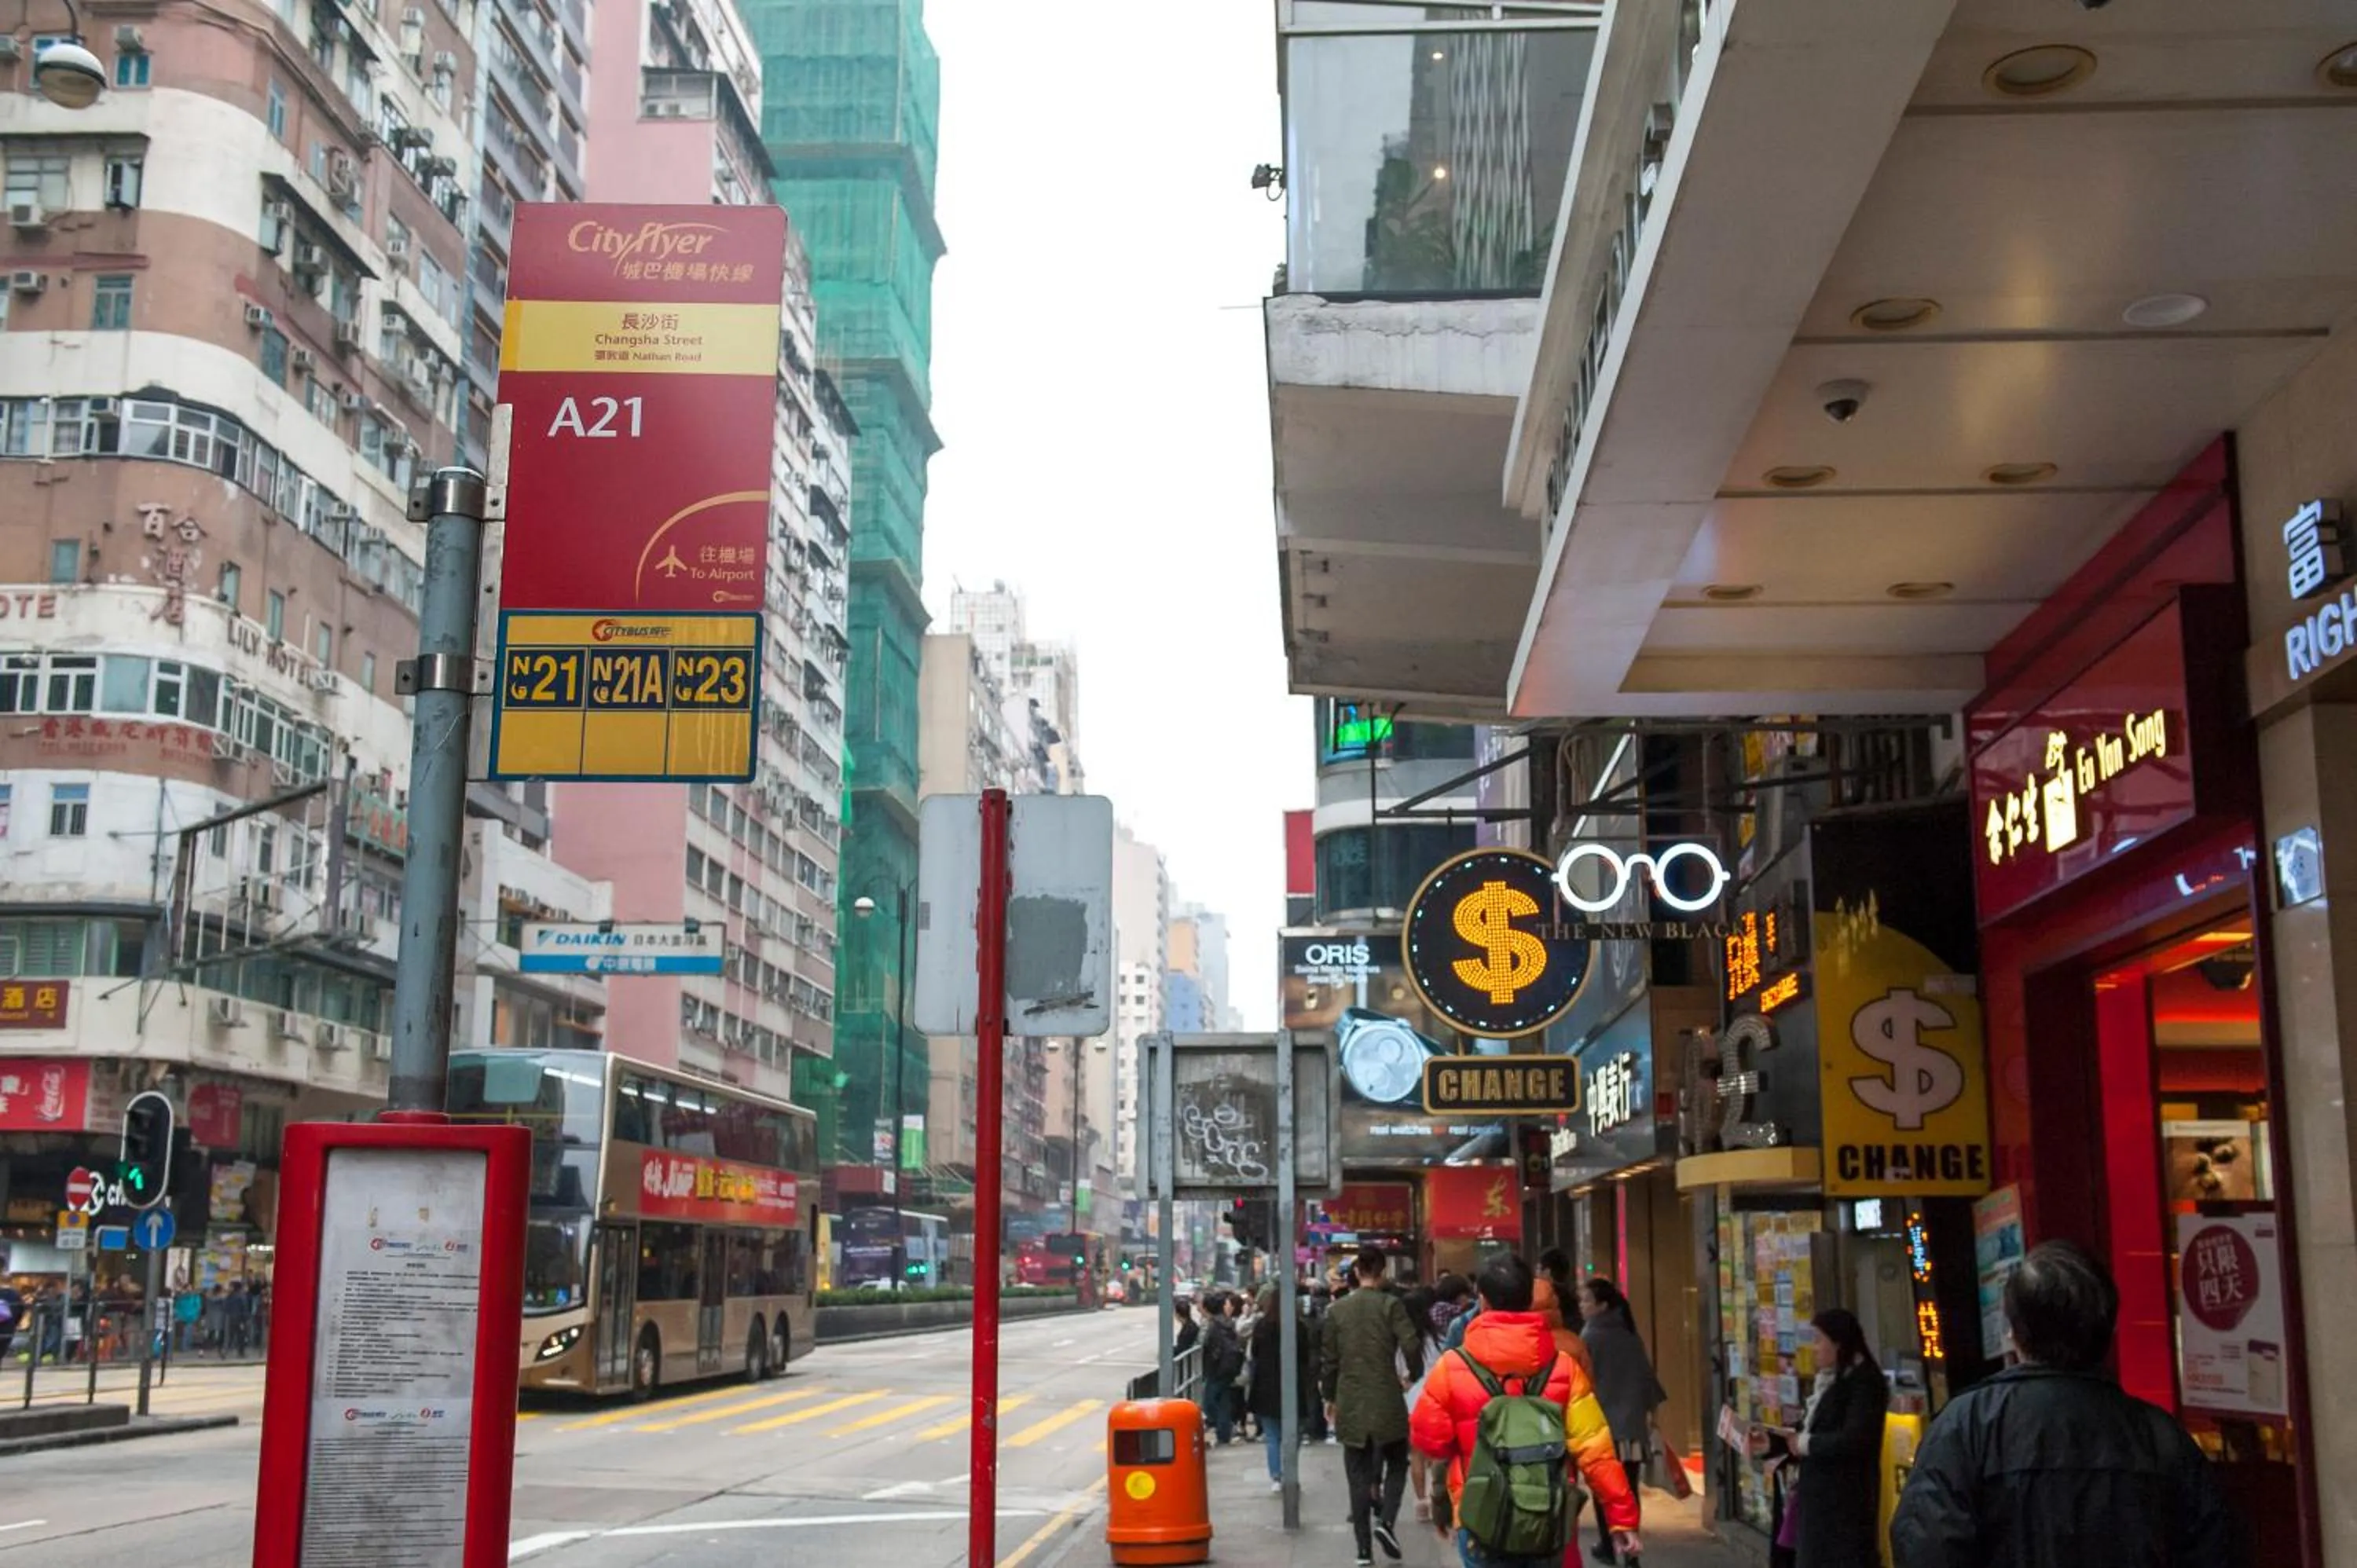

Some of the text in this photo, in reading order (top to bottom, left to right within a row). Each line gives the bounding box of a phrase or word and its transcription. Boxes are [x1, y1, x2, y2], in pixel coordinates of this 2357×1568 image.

[621, 262, 754, 284] 城巴機場快線
[622, 313, 680, 331] 長沙街
[594, 334, 702, 348] Changsha Street
[632, 353, 702, 362] Nathan Road
[548, 396, 643, 438] A21
[699, 546, 755, 564] 往機場
[2283, 499, 2325, 599] 富
[691, 566, 755, 583] To Airport
[228, 618, 261, 655] LILY
[511, 655, 577, 701] N21
[592, 655, 664, 703] N21A
[675, 656, 746, 703] N23
[2076, 709, 2166, 794] Eu Yan Sang
[1985, 772, 2040, 865] 余仁生
[555, 932, 627, 947] DAIKIN
[1536, 921, 1745, 940] THE NEW BLACK
[1305, 943, 1370, 965] ORIS
[1439, 1068, 1566, 1101] CHANGE
[1838, 1145, 1985, 1181] CHANGE
[2199, 1273, 2245, 1306] 四天
